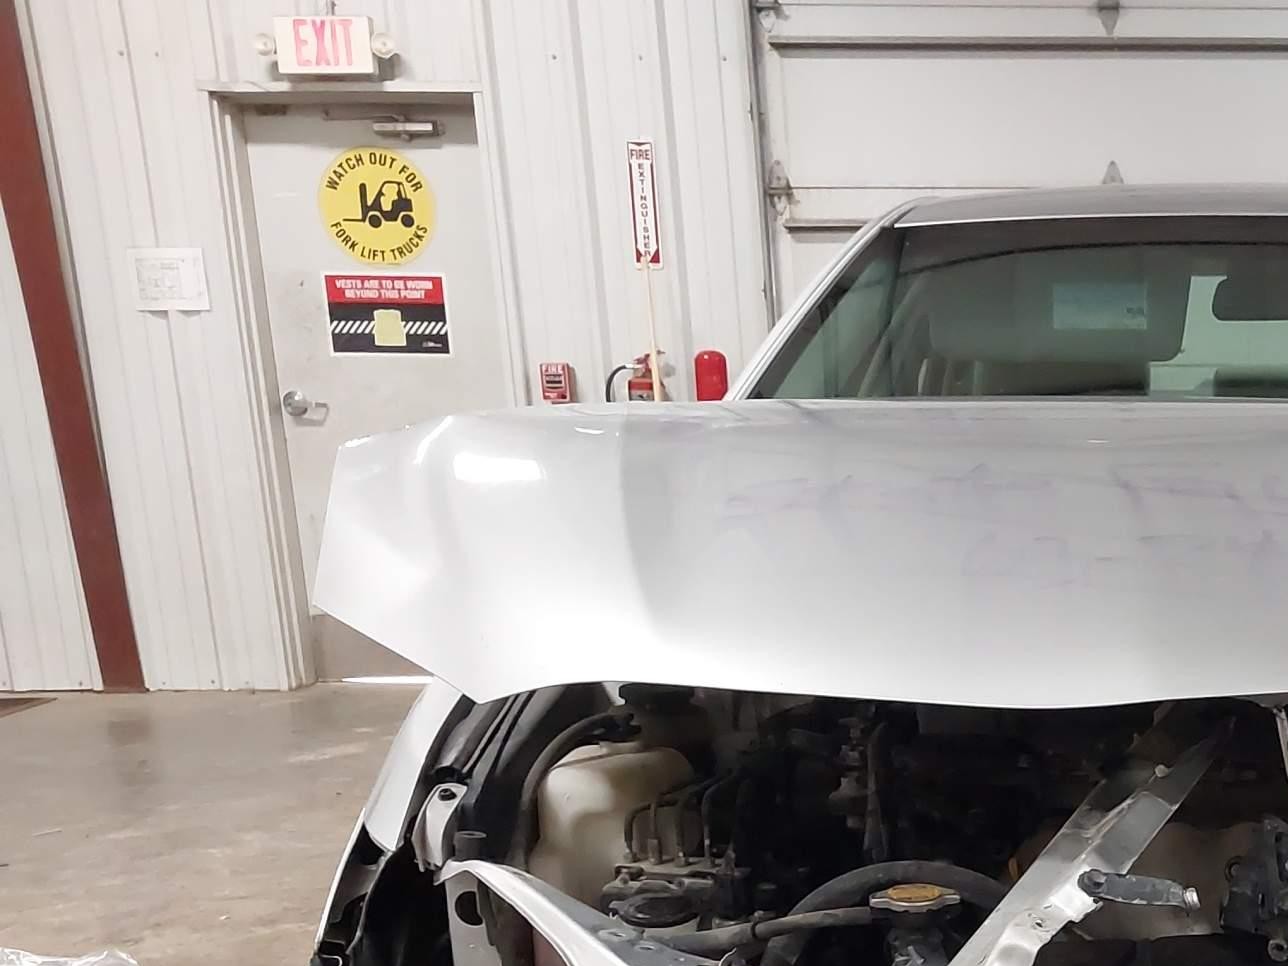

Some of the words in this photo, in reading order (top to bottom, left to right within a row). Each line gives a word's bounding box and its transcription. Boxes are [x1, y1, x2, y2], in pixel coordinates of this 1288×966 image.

[293, 19, 353, 67] EXIT
[325, 153, 365, 191] WATCH
[369, 152, 398, 169] OUT
[398, 165, 423, 192] FOR
[630, 148, 651, 161] FIRE
[638, 162, 652, 257] EXTINGUISHER
[330, 221, 359, 252] FORK
[360, 246, 386, 262] LIFT
[390, 224, 429, 260] TRUCKS
[381, 280, 393, 289] TO
